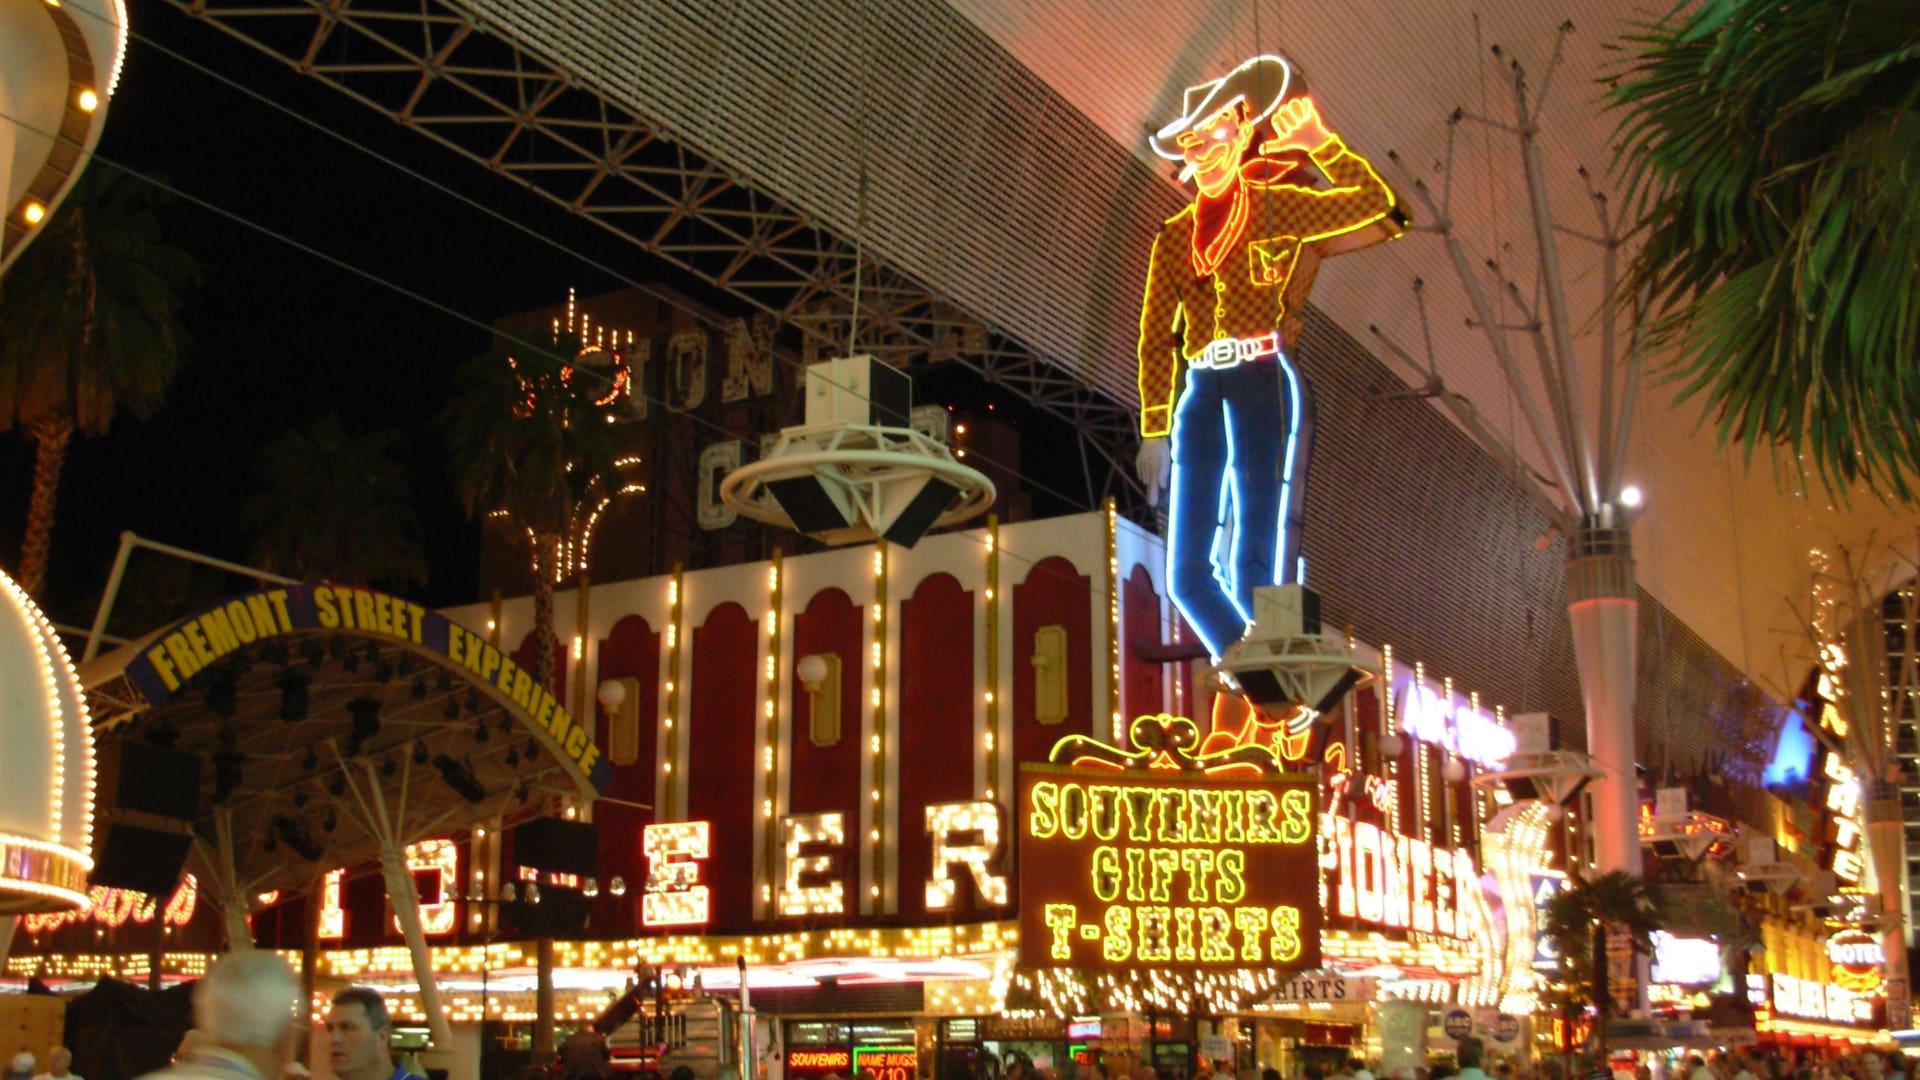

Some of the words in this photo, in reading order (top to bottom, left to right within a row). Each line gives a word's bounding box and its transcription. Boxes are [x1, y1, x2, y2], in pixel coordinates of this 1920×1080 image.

[147, 589, 293, 692] FREMONT
[313, 586, 425, 643] STREET
[449, 623, 600, 775] EXPERIENCE
[1030, 781, 1310, 843] SOUVENIRS
[1091, 846, 1246, 903] GIFTS
[1317, 812, 1474, 941] PIONEER
[1045, 904, 1301, 961] T-SHIRTS
[1275, 979, 1346, 1000] HIRTS
[790, 1053, 848, 1066] SOUVENIRS
[858, 1054, 885, 1067] NAME
[886, 1054, 917, 1067] MUGS
